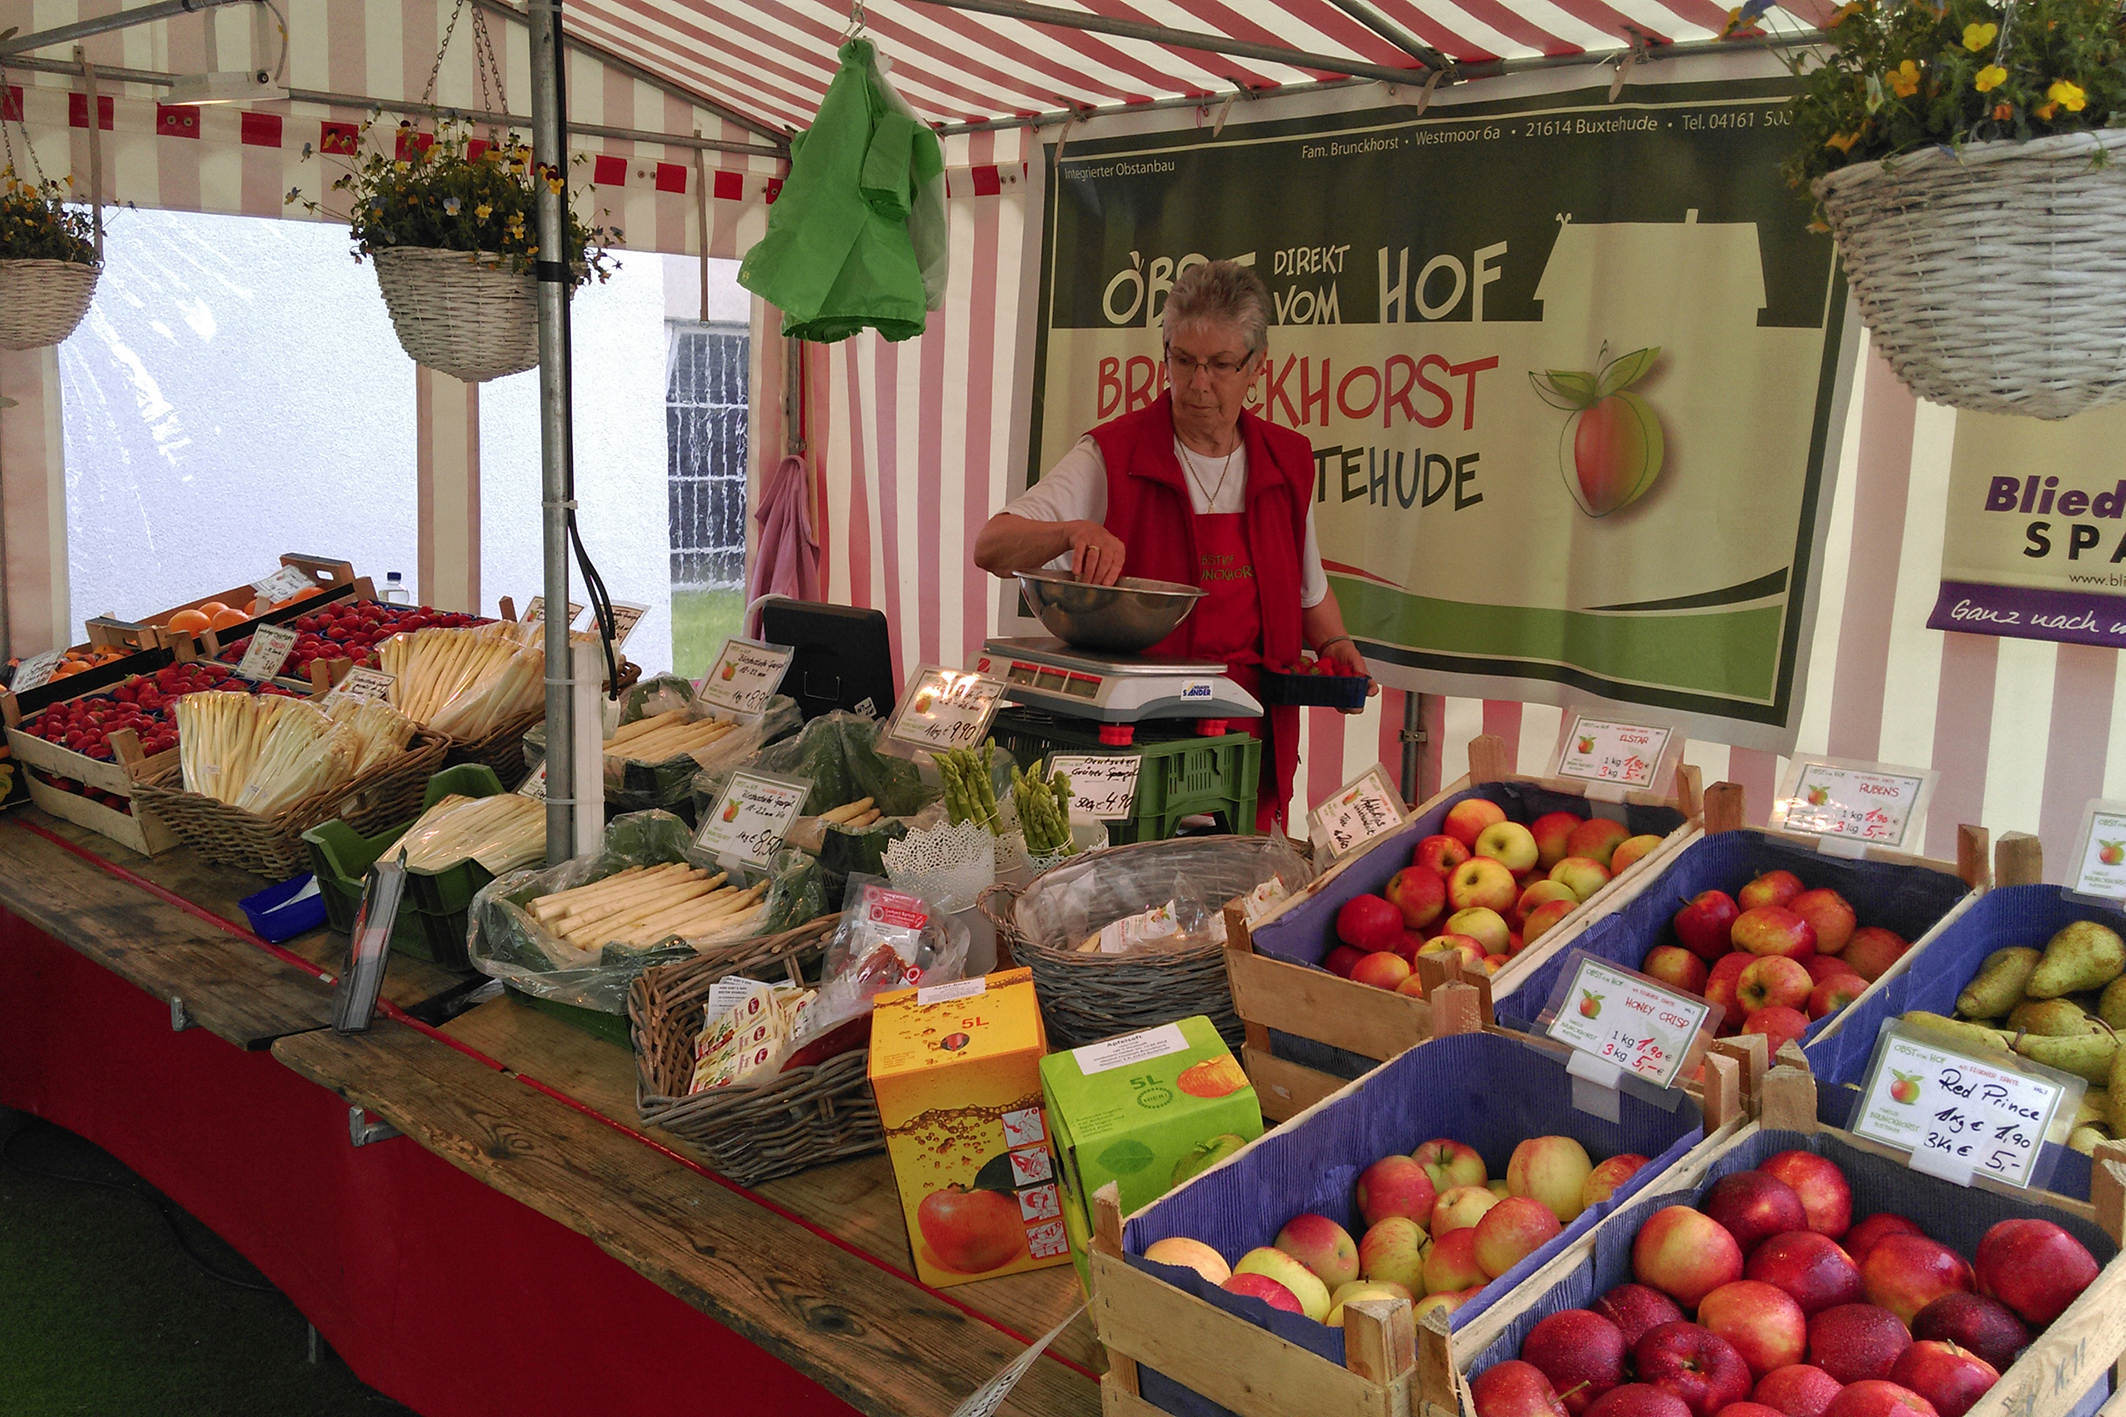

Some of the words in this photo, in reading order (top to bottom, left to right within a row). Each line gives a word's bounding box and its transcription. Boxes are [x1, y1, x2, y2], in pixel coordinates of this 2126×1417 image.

[1301, 144, 1328, 159] Fam.
[1331, 136, 1399, 156] Brunckhorst
[1416, 129, 1480, 145] Westmoor
[1483, 126, 1500, 141] 6a
[1526, 120, 1572, 137] 21614
[1576, 115, 1658, 134] Buxtehude
[1683, 114, 1706, 130] Tel.
[1709, 111, 1754, 129] 04161
[1064, 166, 1114, 181] Integrierter
[1115, 159, 1176, 177] Obstanbau
[1274, 244, 1350, 277] DIREKT
[1377, 240, 1508, 324] HOF
[1274, 280, 1341, 326] VOM
[1951, 598, 2021, 625] Ganz
[2030, 610, 2100, 633] nach
[1182, 688, 1211, 697] SANDER
[949, 720, 977, 743] 9,90
[1619, 734, 1650, 745] ELSTAR
[1598, 766, 1609, 777] 3
[1859, 782, 1900, 798] RUBENS
[1105, 791, 1135, 812] 4,90
[1834, 821, 1845, 833] 3
[1851, 811, 1863, 821] kg
[751, 828, 784, 858] 8,50
[961, 1016, 990, 1030] 5L
[1625, 996, 1656, 1016] HONEY
[1658, 1011, 1690, 1029] CRISP
[1106, 1034, 1143, 1048] Apfelsaft
[1611, 1030, 1618, 1041] 1
[1621, 1033, 1635, 1049] kg
[1636, 1037, 1663, 1059] 1,90
[1602, 1043, 1615, 1056] 3
[1613, 1048, 1628, 1062] kg
[1893, 1043, 1918, 1057] OBST
[1929, 1053, 1947, 1065] HOF
[1129, 1074, 1164, 1091] 5L
[1938, 1068, 1979, 1098] Red
[1981, 1083, 2040, 1121] Prince
[1970, 1120, 1985, 1132] €
[1993, 1123, 2031, 1149] 1,90
[1957, 1145, 1974, 1157] €
